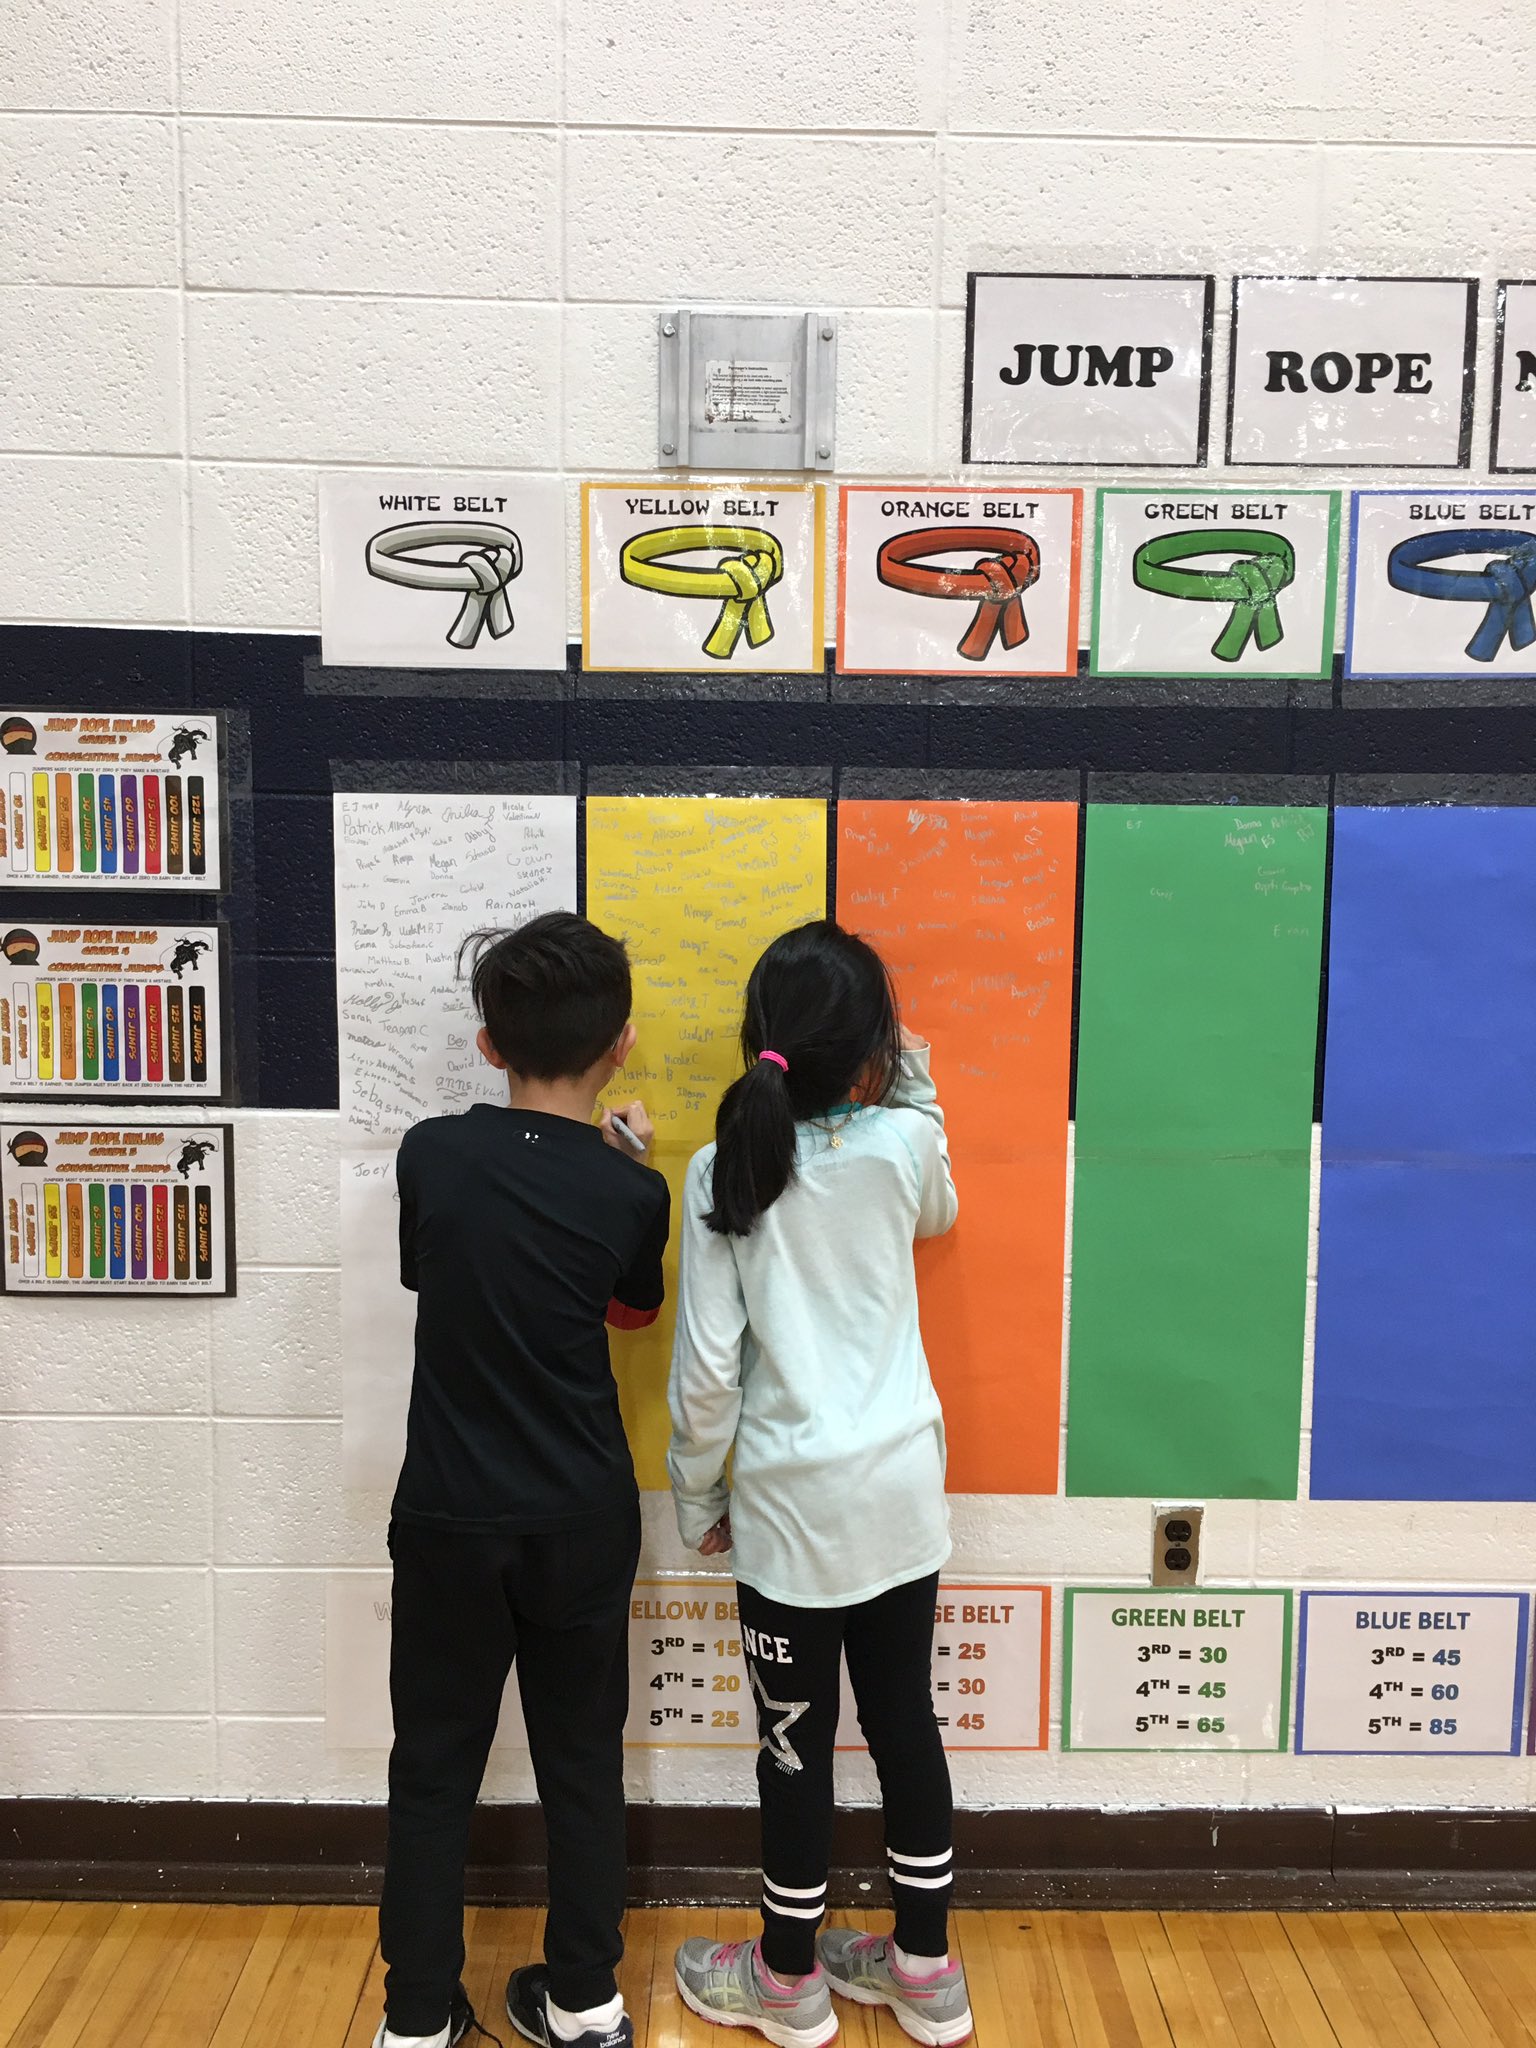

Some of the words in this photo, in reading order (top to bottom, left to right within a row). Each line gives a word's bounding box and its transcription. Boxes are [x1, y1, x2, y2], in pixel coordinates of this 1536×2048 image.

[999, 344, 1173, 388] JUMP
[1264, 350, 1433, 394] ROPE
[379, 495, 441, 512] WHITE
[453, 497, 508, 513] BELT
[625, 499, 710, 516] YELLOW
[723, 499, 779, 517] BELT
[880, 500, 970, 518] ORANGE
[982, 502, 1039, 519] BELT
[1144, 503, 1218, 521] GREEN
[1231, 503, 1288, 521] BELT
[1409, 504, 1466, 520] BLUE
[1479, 504, 1535, 520] BELT
[44, 718, 78, 732] JUMP
[80, 718, 110, 733] ROPE
[112, 718, 156, 733] NINJAS
[45, 752, 119, 762] CONSECUTIVE
[121, 753, 162, 763] JUMPS
[103, 797, 112, 812] 45
[125, 797, 134, 812] 60
[169, 795, 179, 815] 100
[191, 795, 201, 815] 125
[84, 815, 93, 852] JUMPS
[104, 815, 113, 852] JUMPS
[126, 815, 135, 852] JUMPS
[149, 814, 157, 852] JUMPS
[342, 814, 386, 837] Patrick
[170, 817, 179, 856] JUMPS
[192, 817, 202, 856] JUMPS
[429, 853, 458, 873] Megan
[517, 867, 553, 880] Sydney
[47, 929, 81, 943] JUMP
[83, 930, 113, 943] ROPE
[115, 930, 158, 944] NINJAS
[48, 962, 122, 972] CONSECUTIVE
[124, 963, 164, 973] JUMPS
[105, 1006, 114, 1021] 60
[149, 1004, 157, 1023] 100
[171, 1004, 180, 1023] 125
[193, 1004, 202, 1022] 175
[86, 1023, 95, 1059] JUMPS
[106, 1024, 115, 1059] JUMPS
[128, 1022, 137, 1060] JUMPS
[150, 1026, 158, 1063] JUMPS
[172, 1026, 180, 1063] JUMPS
[194, 1024, 203, 1064] JUMPS
[448, 1034, 468, 1047] Ben
[447, 1055, 474, 1072] David
[55, 1131, 88, 1145] JUMP
[90, 1131, 120, 1145] ROPE
[123, 1132, 164, 1146] NINJAS
[56, 1163, 129, 1172] CONSECUTIVE
[131, 1164, 171, 1173] JUMPS
[352, 1162, 390, 1178] Joey
[135, 1203, 143, 1222] 100
[156, 1204, 164, 1222] 125
[177, 1204, 186, 1220] 175
[199, 1203, 208, 1225] 250
[94, 1222, 102, 1258] JUMPS
[113, 1222, 122, 1258] JUMPS
[135, 1224, 143, 1261] JUMPS
[156, 1225, 164, 1261] JUMPS
[177, 1223, 186, 1262] JUMPS
[199, 1226, 208, 1262] JUMPS
[631, 1601, 709, 1620] ELLOW
[714, 1602, 741, 1621] BE
[962, 1605, 1014, 1624] BELT
[1111, 1608, 1186, 1627] GREEN
[1193, 1609, 1245, 1627] BELT
[1356, 1611, 1411, 1630] BLUE
[1418, 1612, 1471, 1630] BELT
[651, 1637, 685, 1656] 3RD
[713, 1640, 741, 1657] 15
[743, 1624, 793, 1663] NCE
[958, 1642, 986, 1660] 25
[1137, 1644, 1171, 1662] 3RD
[1199, 1647, 1227, 1664] 30
[1371, 1647, 1405, 1665] 3RD
[1432, 1649, 1461, 1666] 45
[650, 1672, 684, 1690] 4TH
[712, 1675, 740, 1692] 20
[957, 1678, 986, 1695] 30
[1136, 1679, 1170, 1697] 4TH
[1197, 1682, 1226, 1698] 45
[1369, 1681, 1403, 1699] 4TH
[1431, 1684, 1459, 1701] 60
[650, 1708, 683, 1726] 5TH
[711, 1711, 740, 1727] 25
[956, 1713, 985, 1730] 45
[1135, 1714, 1169, 1733] 5TH
[1197, 1716, 1225, 1733] 65
[1368, 1716, 1402, 1735] 5TH
[1429, 1718, 1457, 1735] 85
